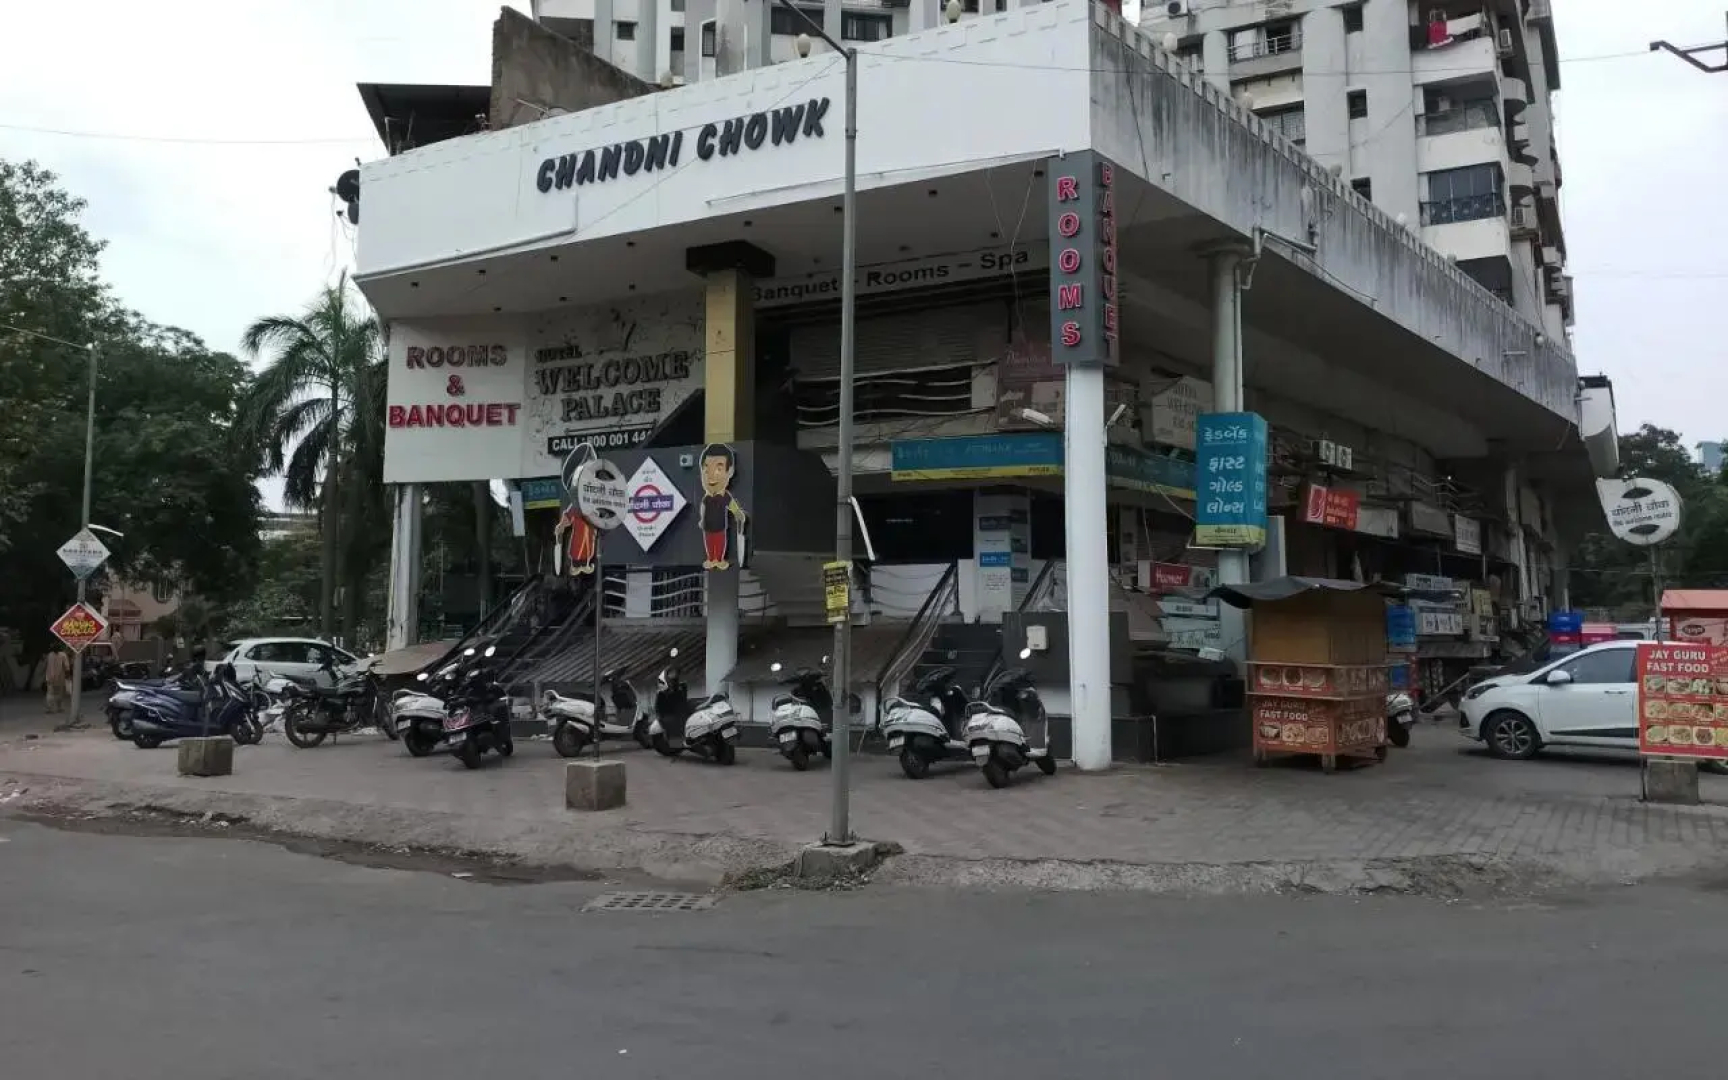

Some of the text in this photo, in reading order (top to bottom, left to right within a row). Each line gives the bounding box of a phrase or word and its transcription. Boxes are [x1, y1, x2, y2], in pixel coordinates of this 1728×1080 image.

[536, 97, 830, 193] CHANDNI CHOWK
[867, 263, 949, 288] Rooms
[980, 249, 1029, 274] Spa
[1057, 176, 1081, 346] ROOMS
[1101, 161, 1117, 355] BANQUET
[407, 344, 507, 369] ROOMS
[446, 375, 466, 396] &
[536, 350, 691, 395] WELCOME
[389, 403, 521, 429] BANQUET
[561, 388, 660, 422] PALACE
[1646, 661, 1710, 673] FAST FOOD
[1648, 649, 1669, 660] JAY
[1673, 650, 1706, 661] GURU
[1260, 709, 1309, 721] FAST FOOD
